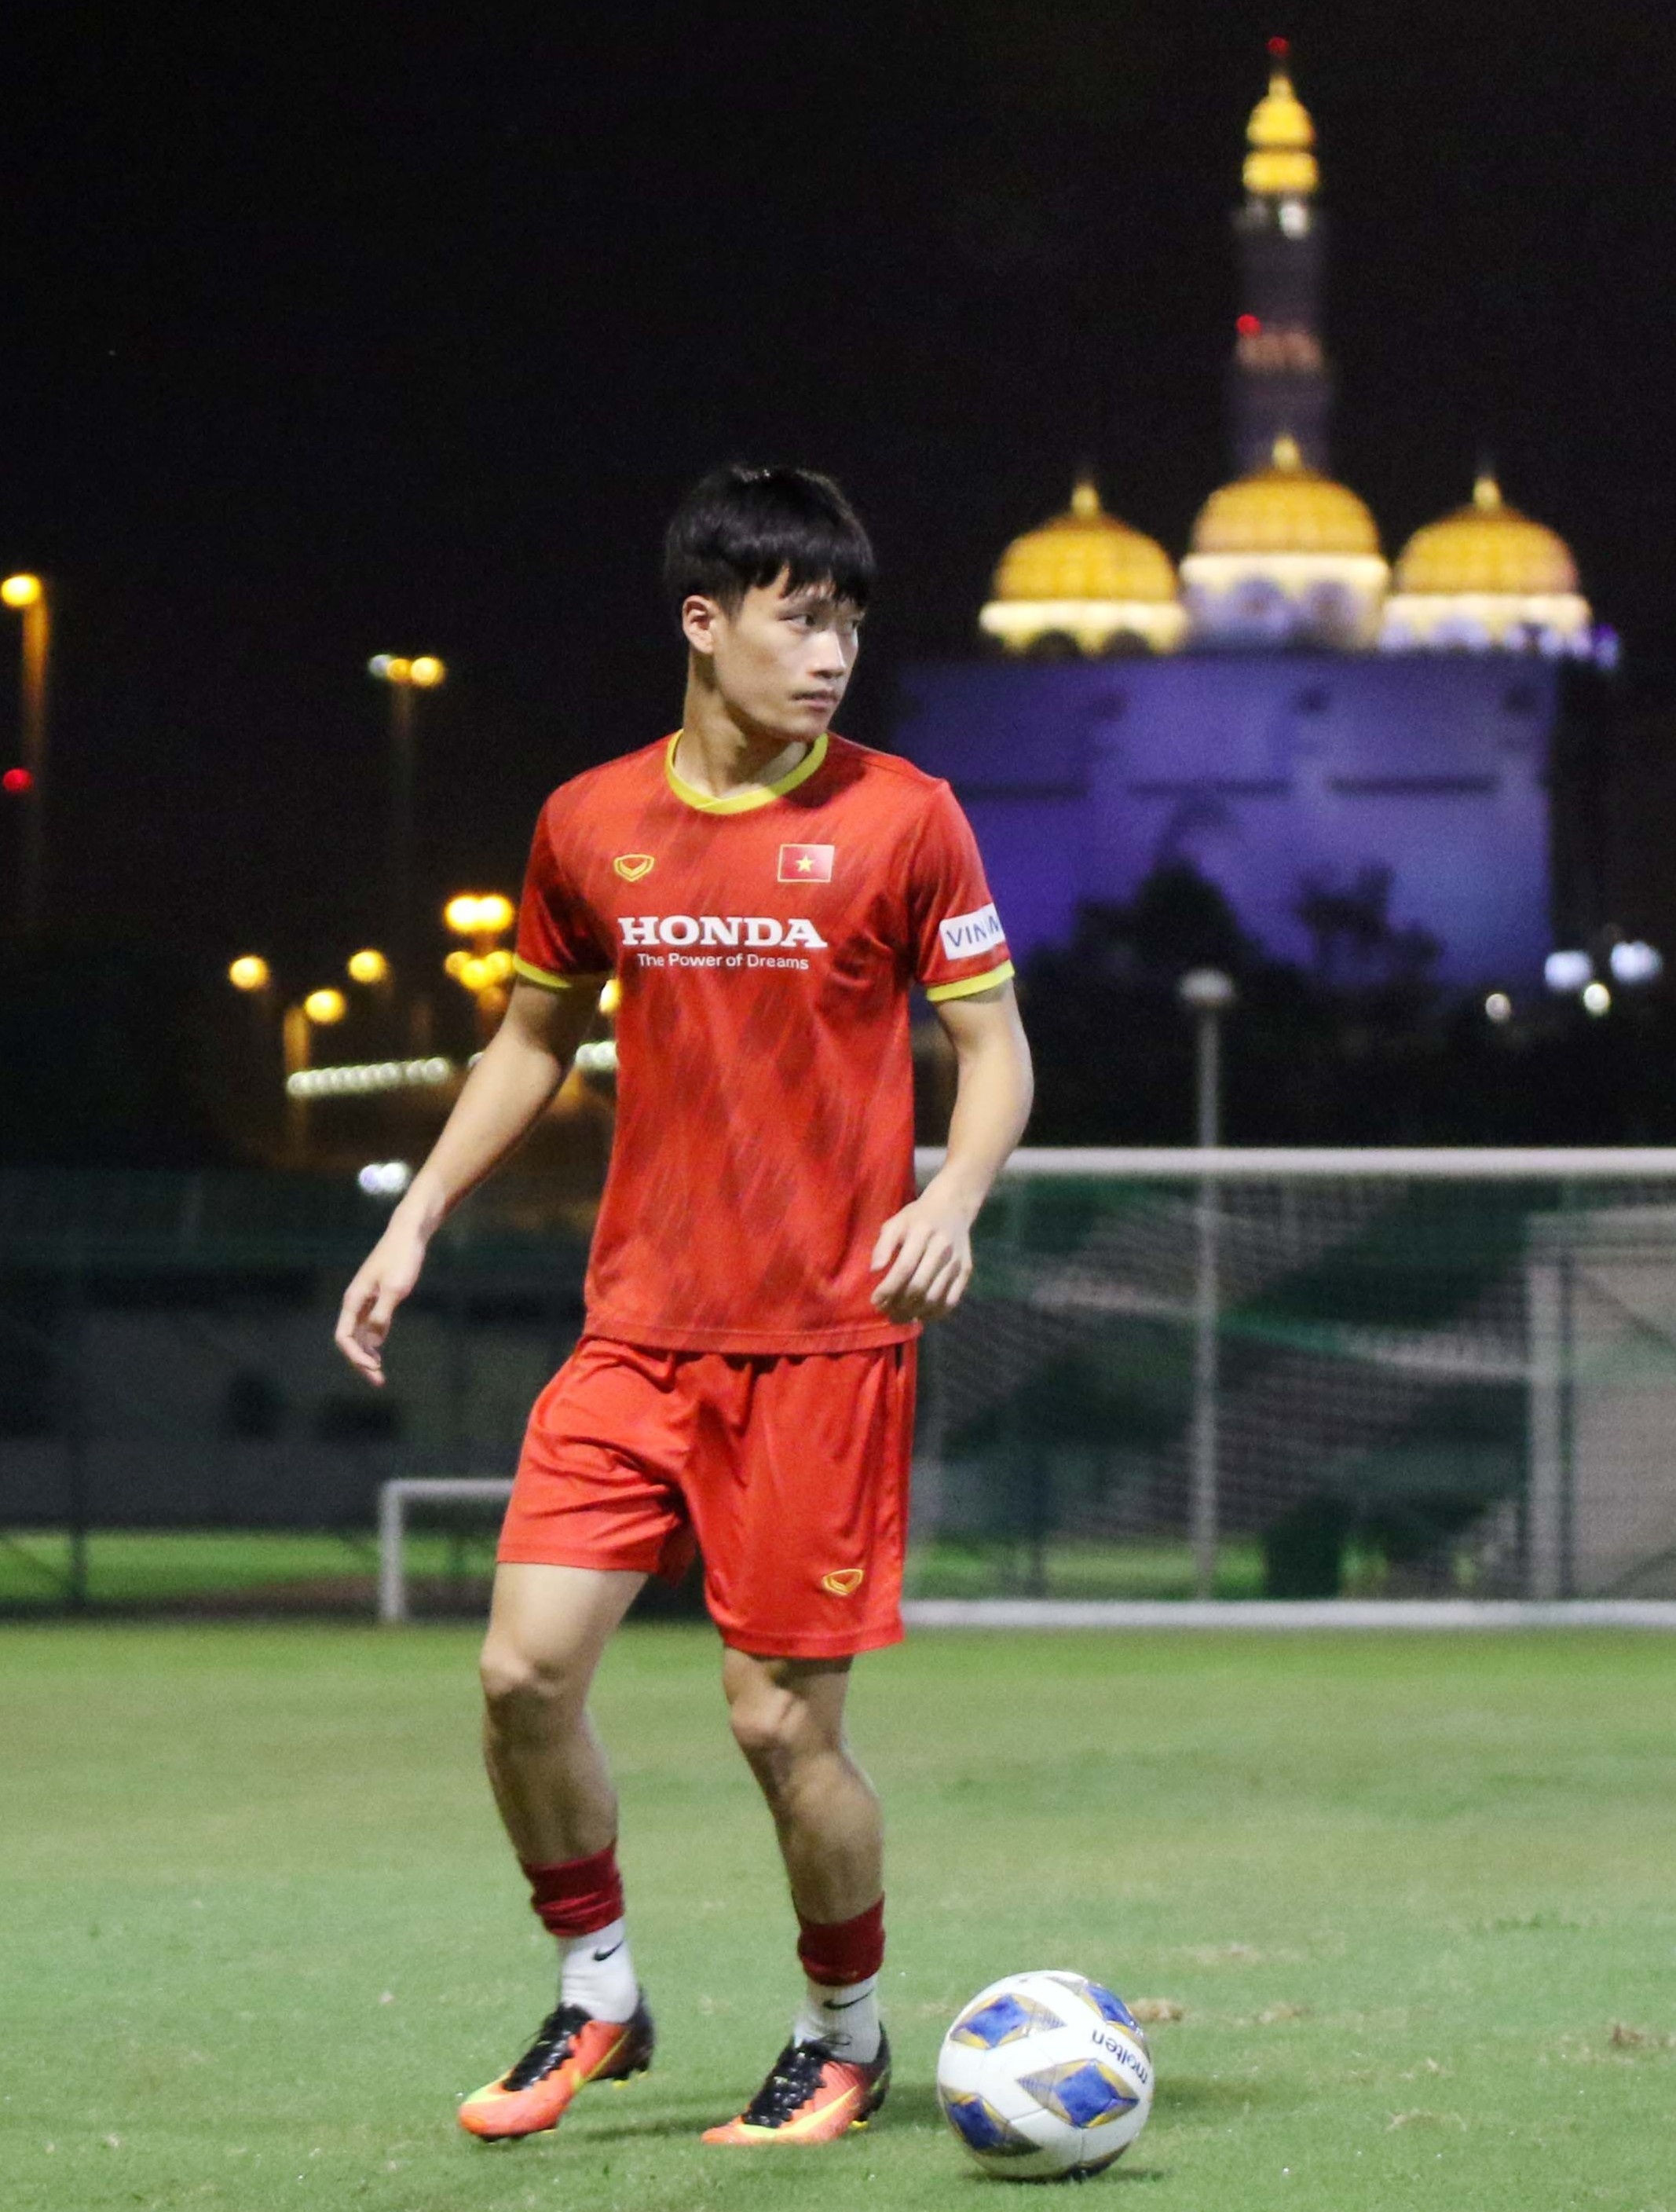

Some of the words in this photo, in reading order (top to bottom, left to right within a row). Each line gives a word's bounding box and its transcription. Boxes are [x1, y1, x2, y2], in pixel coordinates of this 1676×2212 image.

[617, 914, 828, 948] HONDA
[637, 953, 664, 968] The
[669, 952, 723, 968] Power
[726, 953, 743, 968] of
[747, 954, 810, 971] Dreams
[1092, 2029, 1148, 2085] molten
